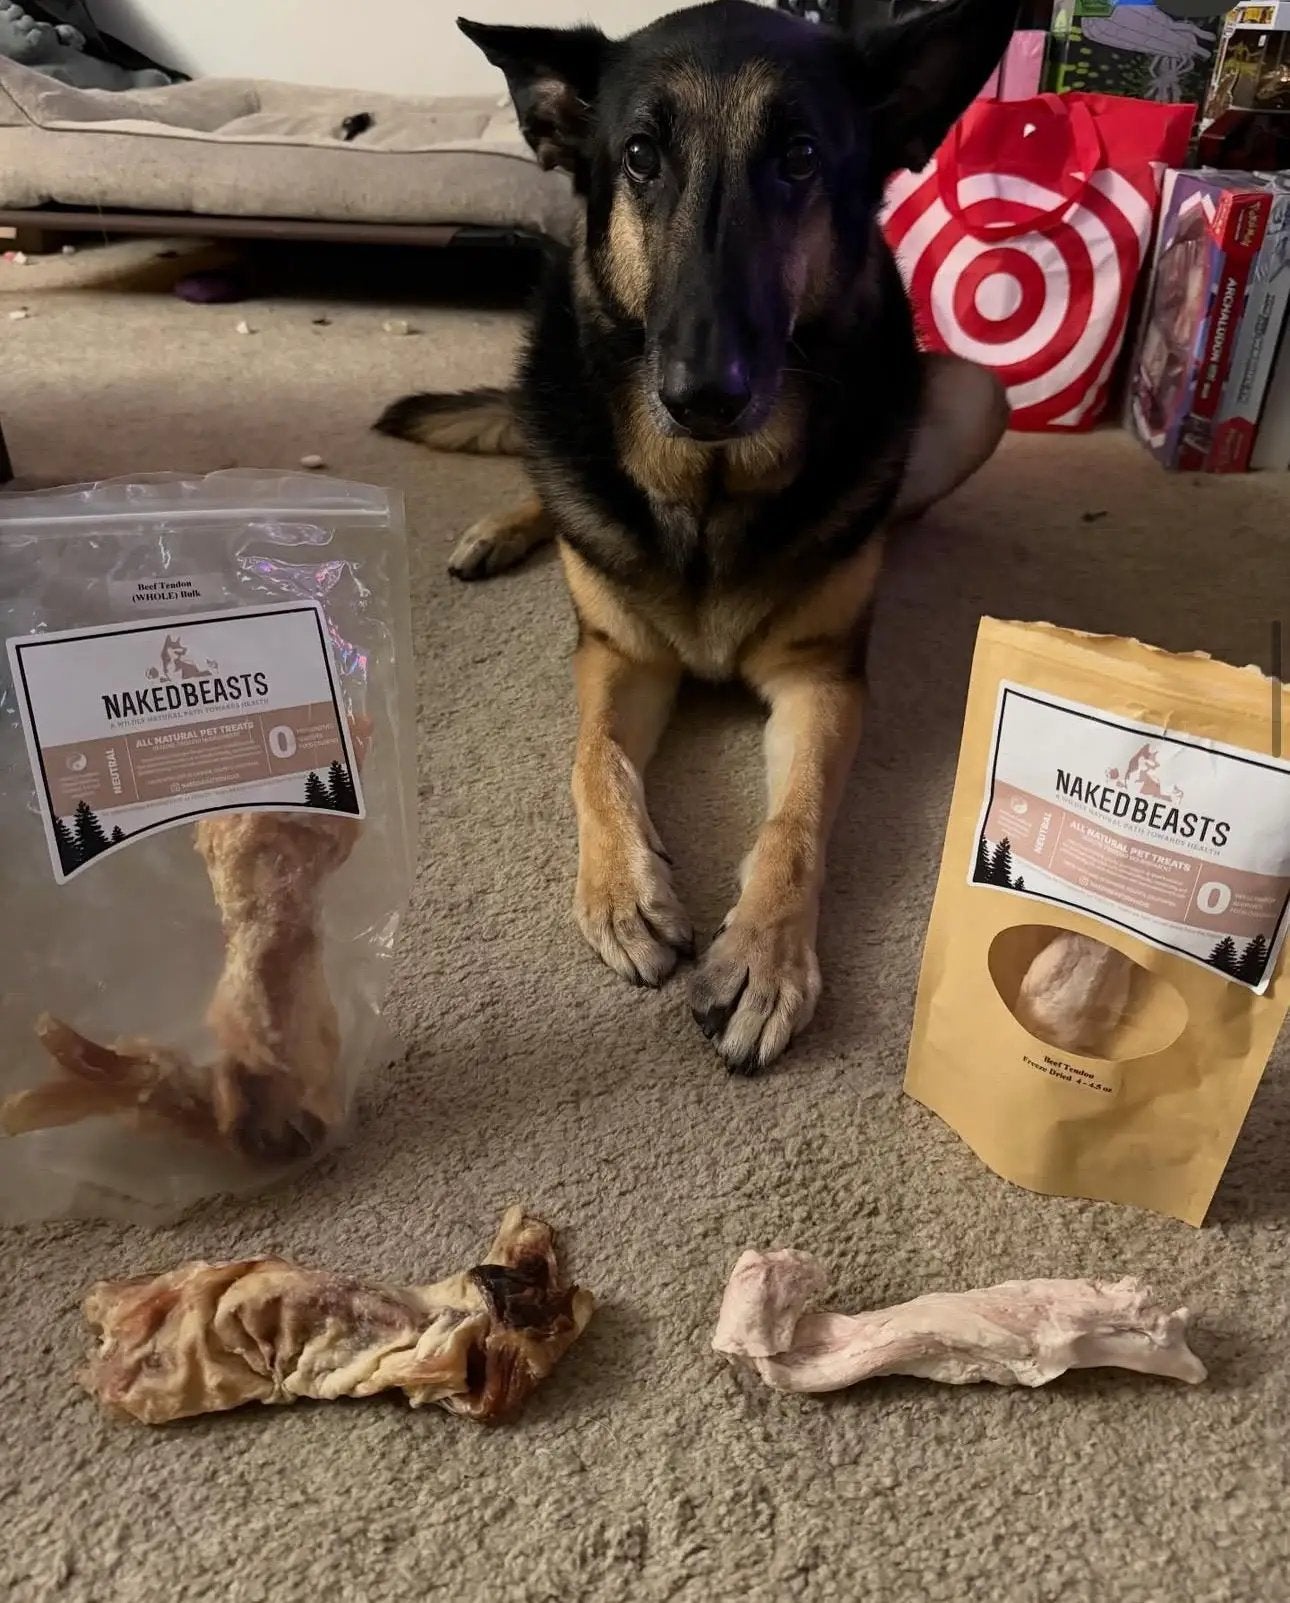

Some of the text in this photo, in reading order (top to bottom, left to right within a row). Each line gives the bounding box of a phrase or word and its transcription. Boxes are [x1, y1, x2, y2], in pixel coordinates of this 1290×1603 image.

[132, 590, 201, 603] (WHOLE) Bulk
[138, 580, 192, 591] Beef Tendon
[102, 672, 269, 720] NAKEDBEASTS
[135, 721, 254, 748] ALL NATURAL PET TREATS
[104, 748, 123, 795] NEUTRAL
[1055, 769, 1231, 847] NAKEDBEASTS
[1033, 812, 1052, 855] NEUTRAL
[1070, 820, 1192, 873] ALL NATURAL PET TREATS
[1023, 1055, 1048, 1073] Freeze
[1049, 1068, 1072, 1082] Dried
[1043, 1055, 1095, 1080] Beef Tendon
